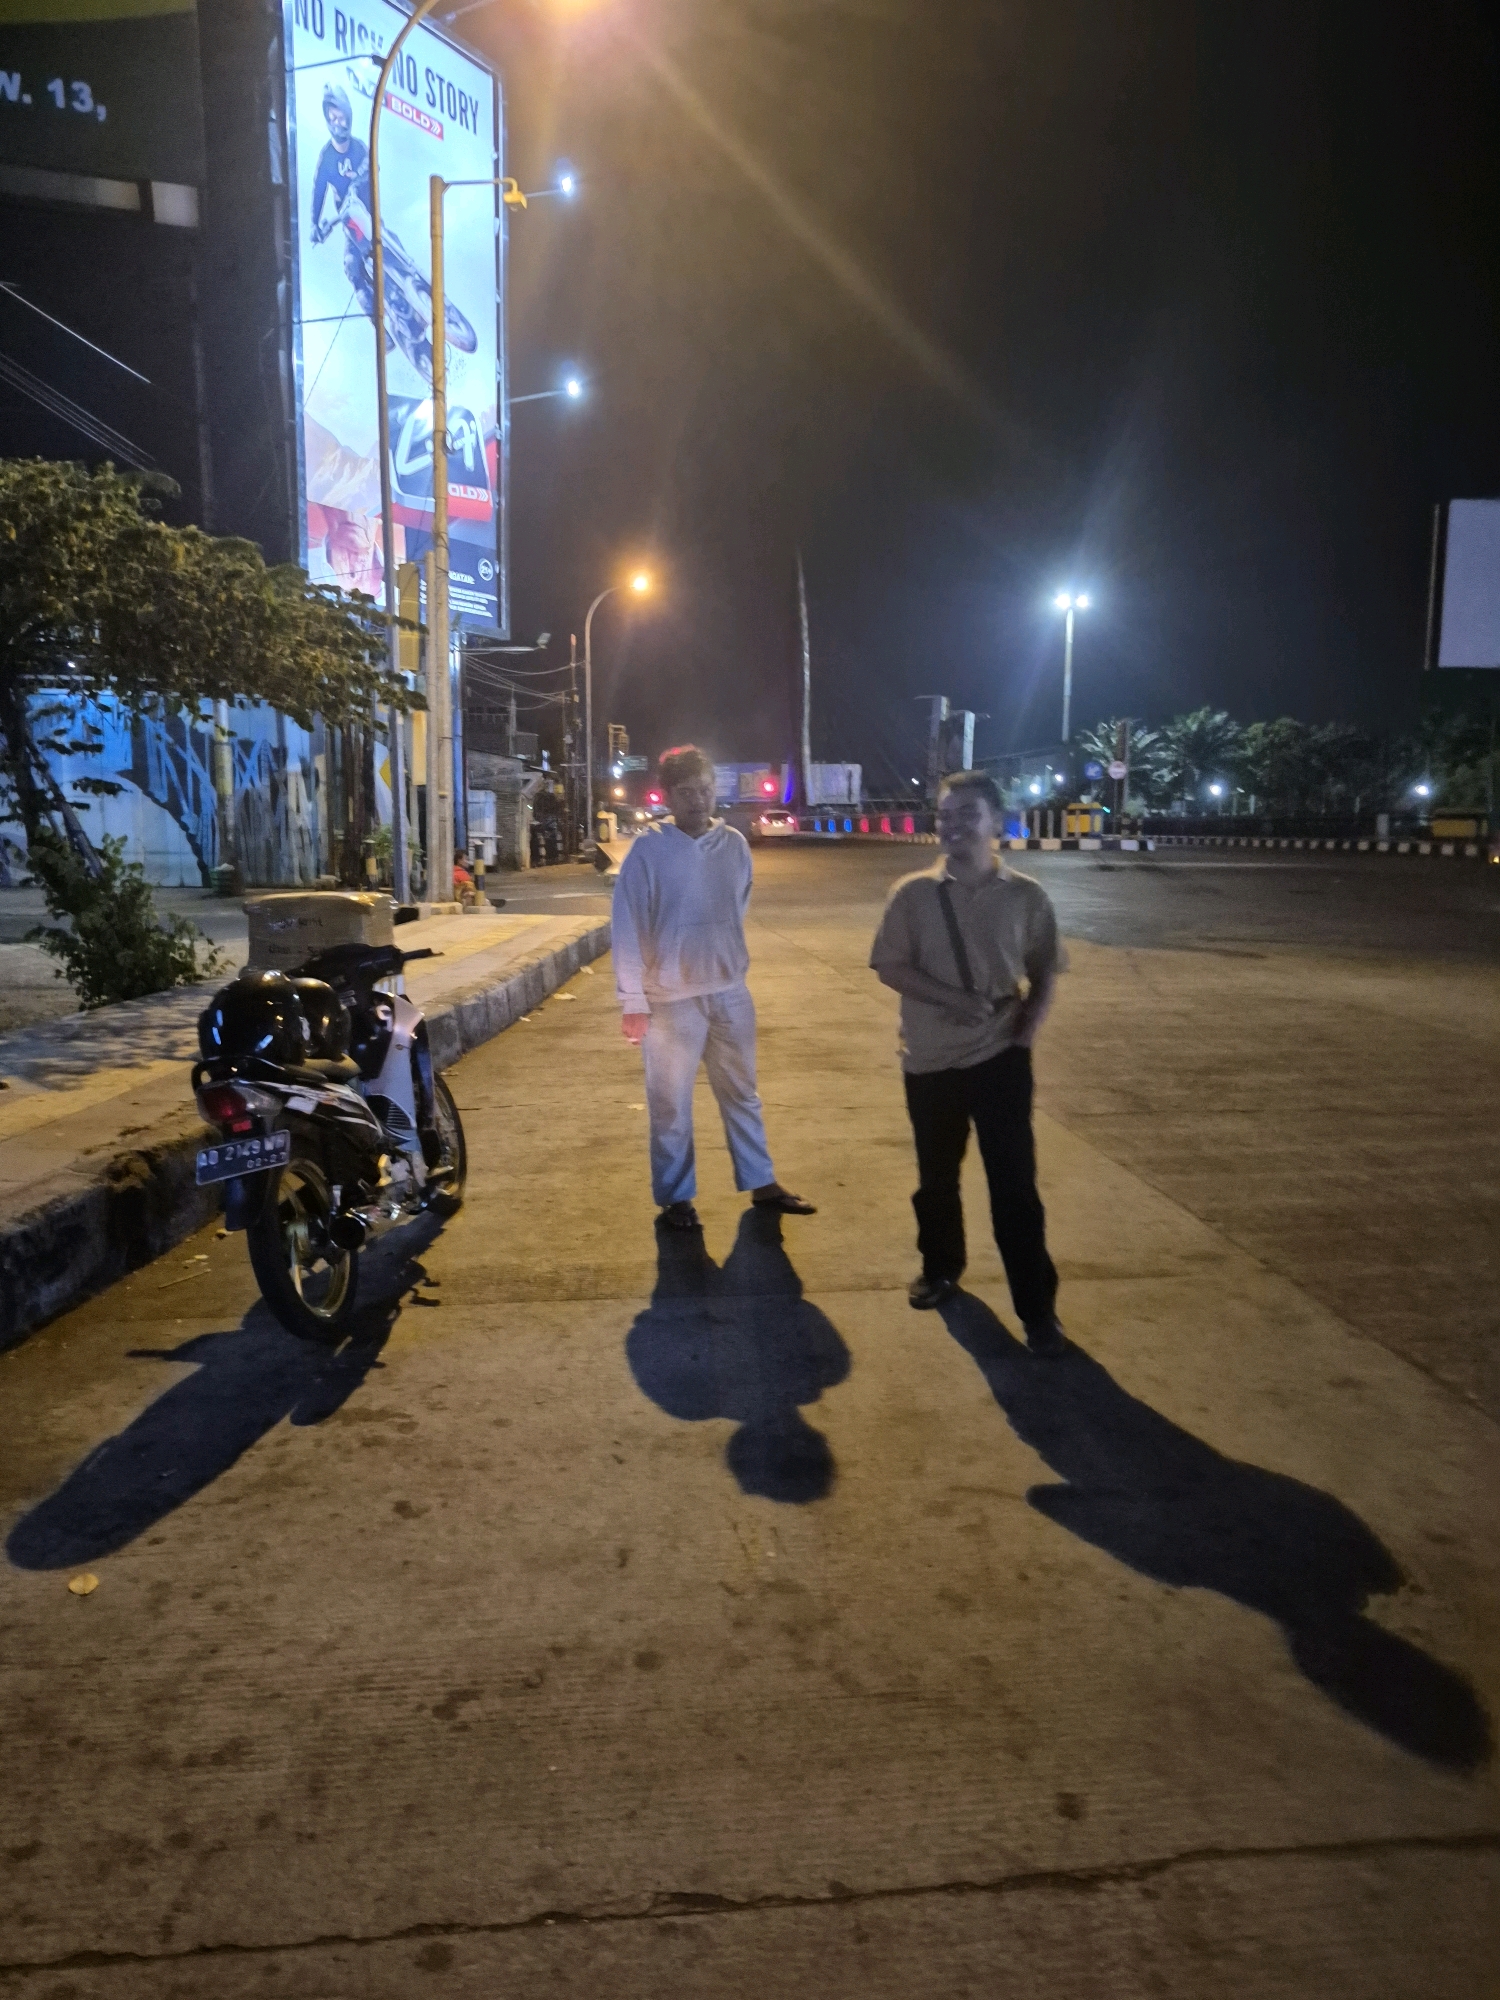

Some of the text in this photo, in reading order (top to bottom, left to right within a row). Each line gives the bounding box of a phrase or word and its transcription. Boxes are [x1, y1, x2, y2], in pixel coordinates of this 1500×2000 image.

[295, 0, 325, 40] NO
[393, 51, 418, 97] NO
[425, 67, 479, 136] STORY
[47, 78, 107, 122] 13,
[391, 95, 431, 130] BOLD
[447, 483, 478, 500] OLD
